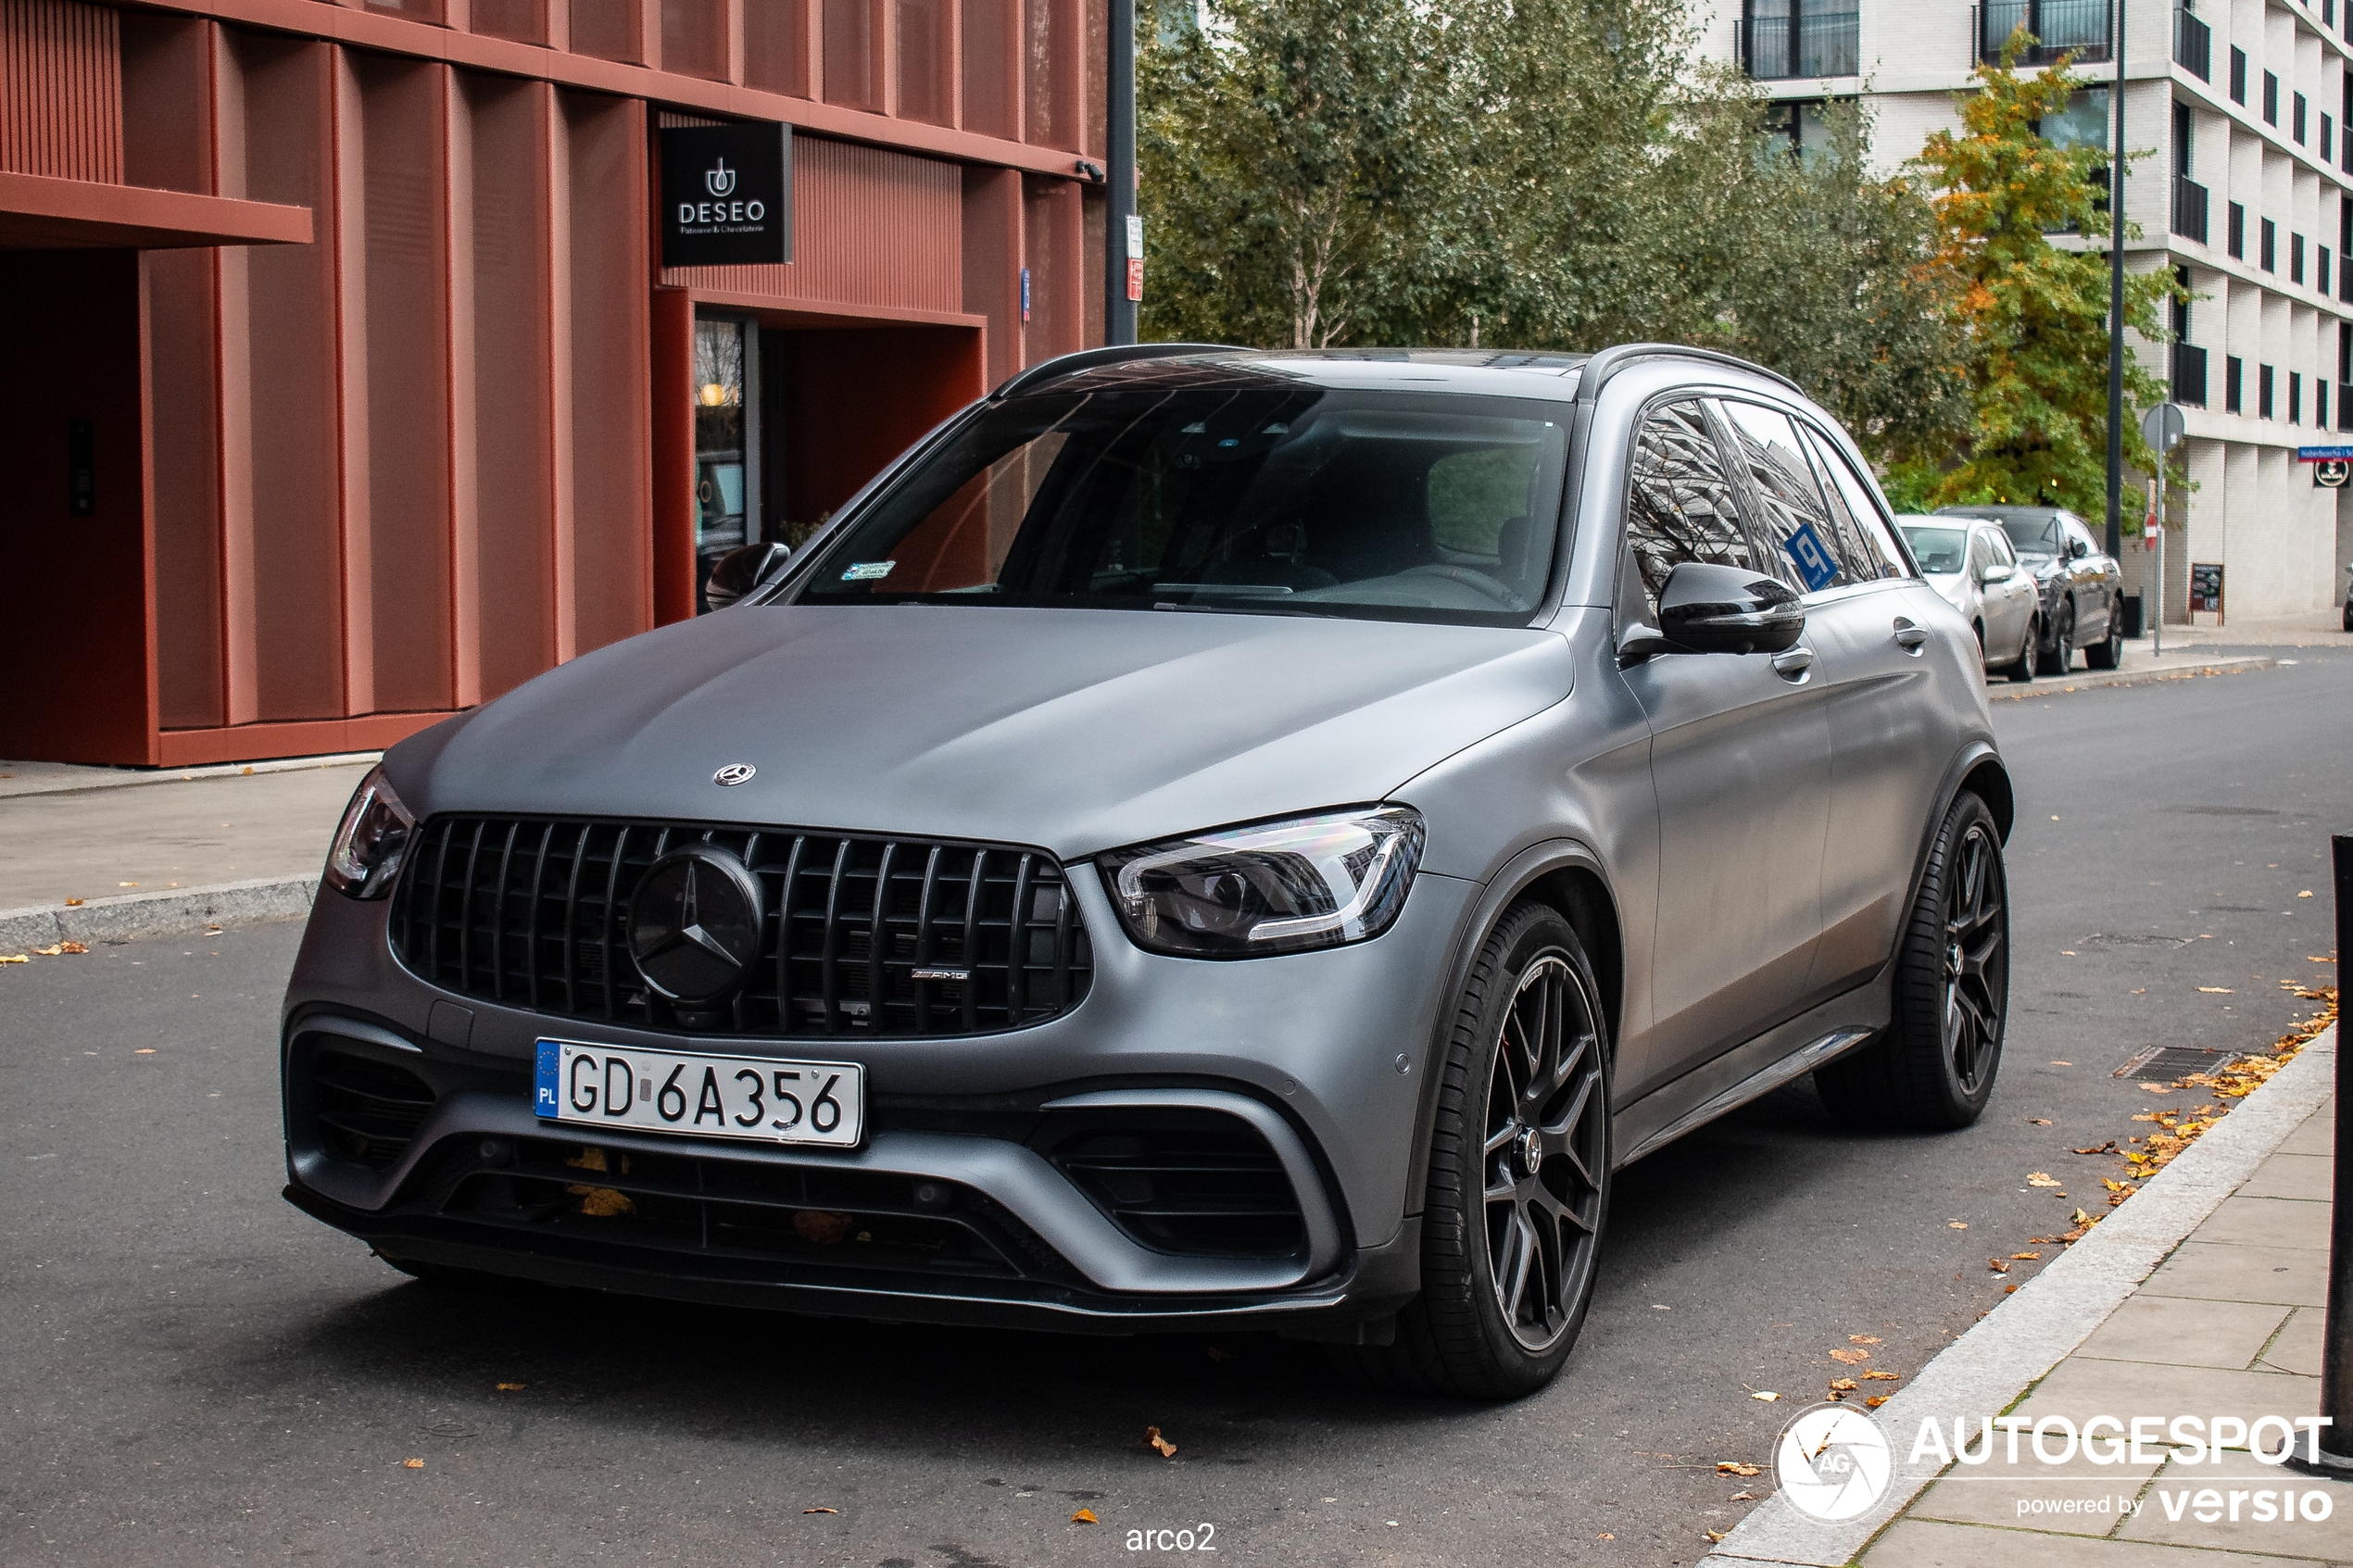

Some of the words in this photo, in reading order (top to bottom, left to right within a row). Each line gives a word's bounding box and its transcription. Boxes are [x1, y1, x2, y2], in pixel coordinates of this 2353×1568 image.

[678, 200, 764, 223] DESEO
[713, 225, 720, 233] &
[539, 1087, 556, 1105] PL
[571, 1053, 634, 1116] GD
[657, 1062, 842, 1133] 6A356
